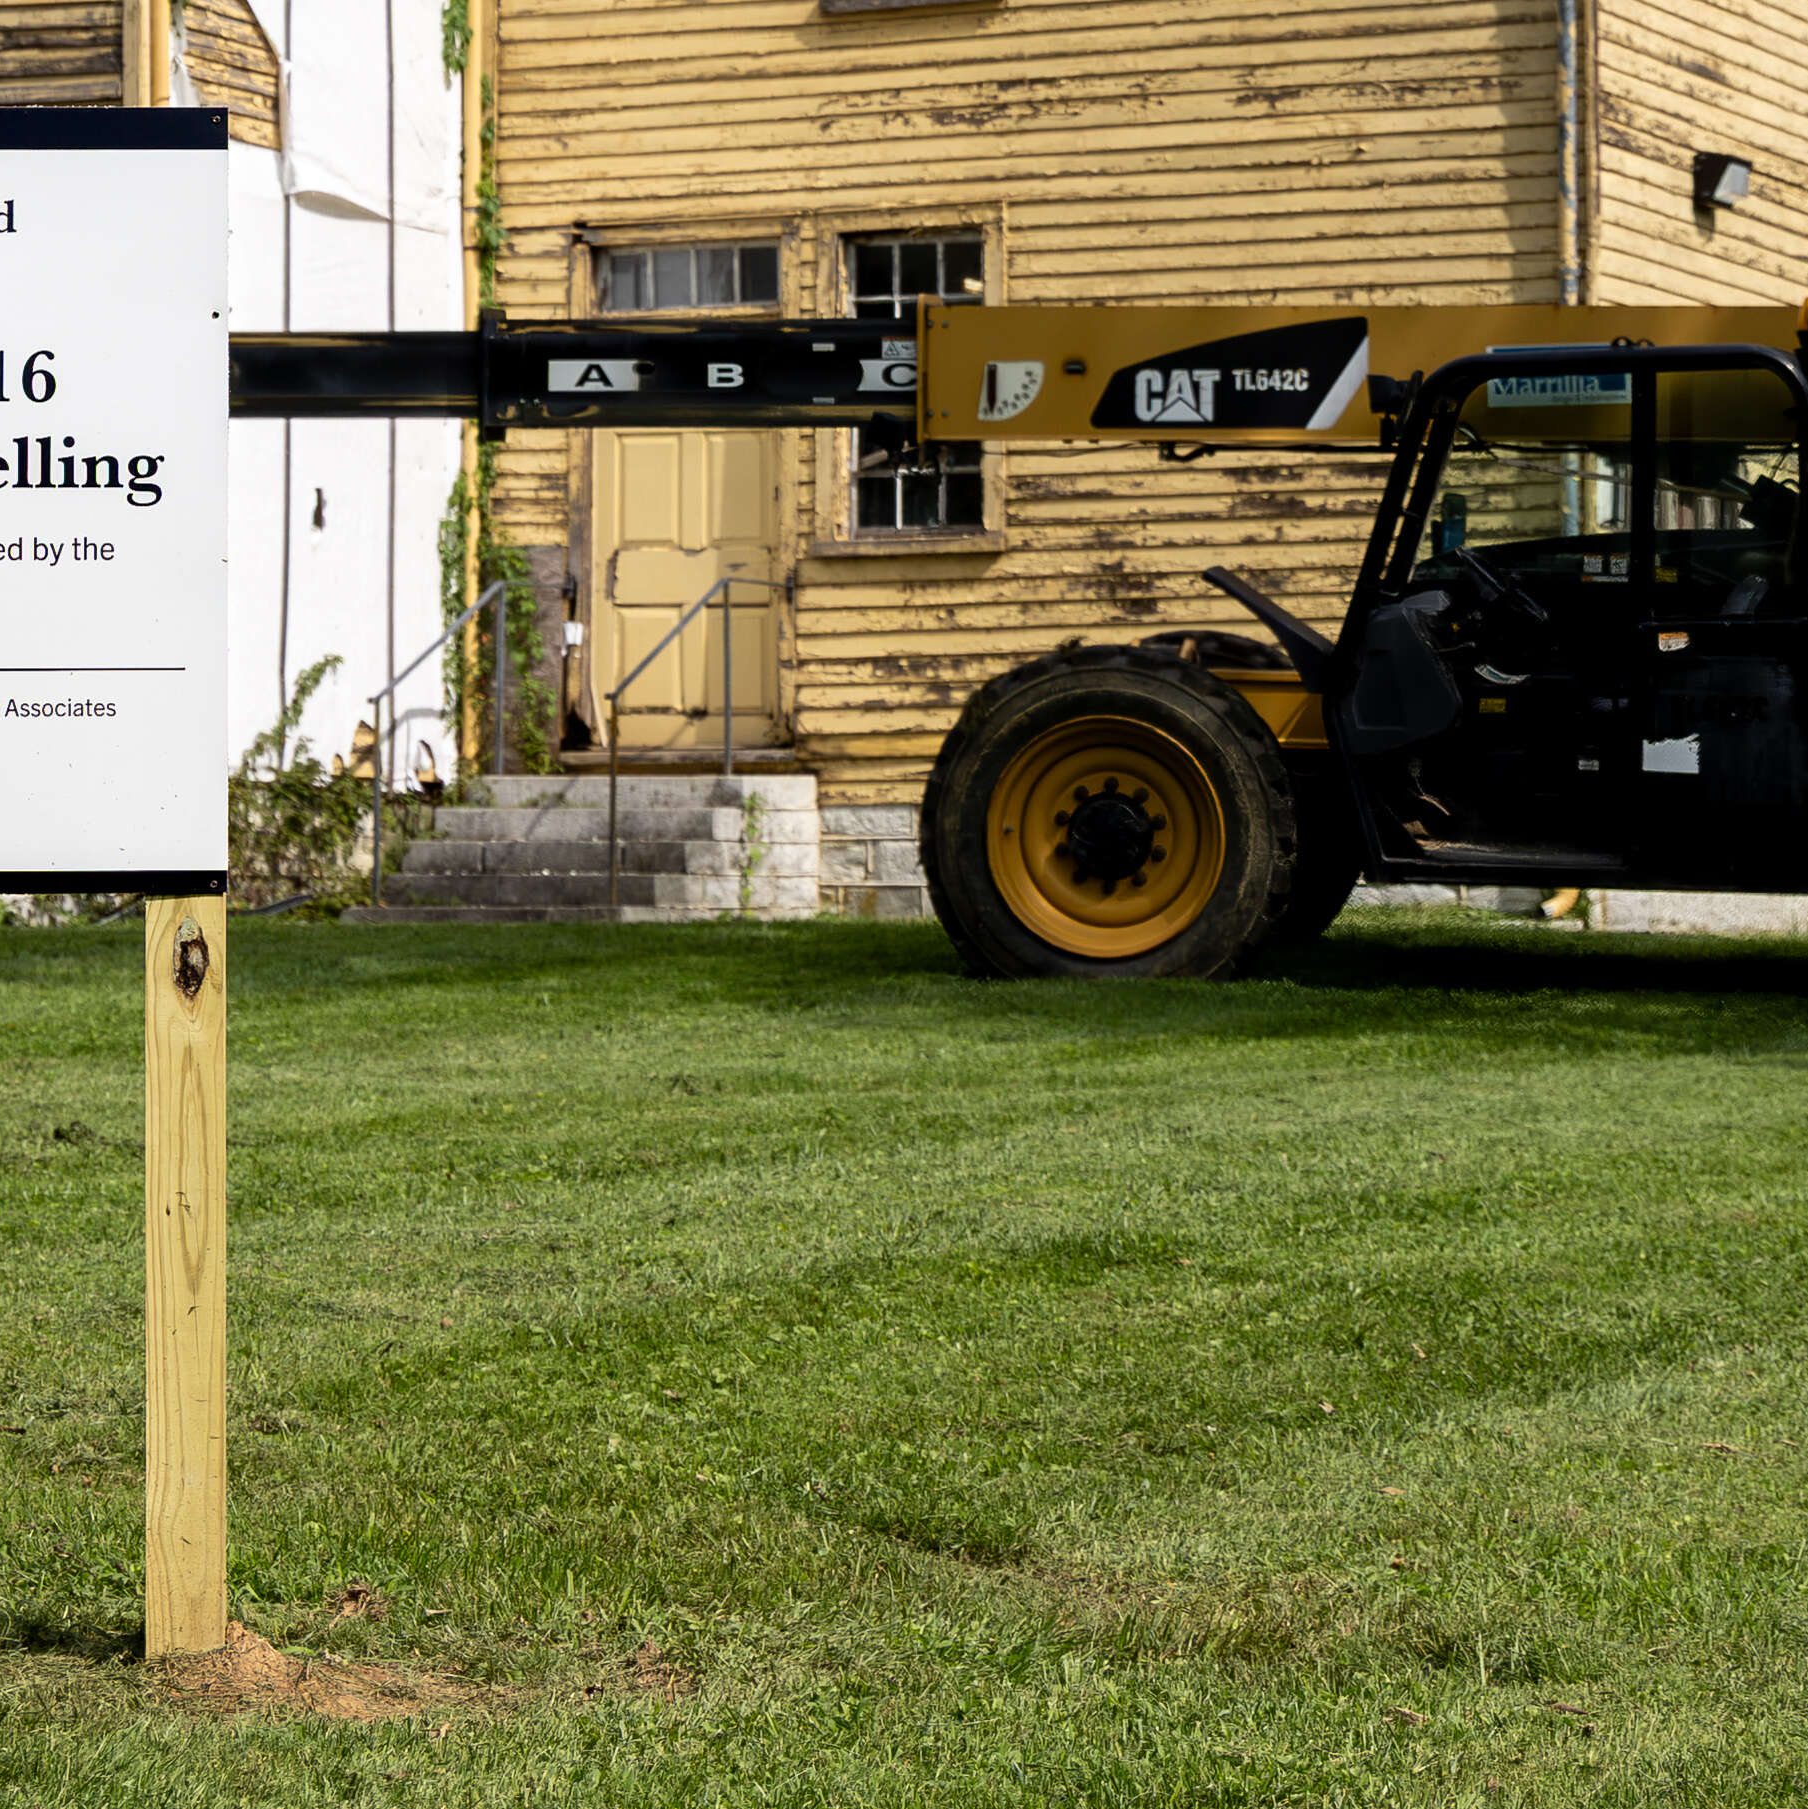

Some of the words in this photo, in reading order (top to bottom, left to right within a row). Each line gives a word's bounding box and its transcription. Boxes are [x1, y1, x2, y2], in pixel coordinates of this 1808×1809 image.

[575, 364, 613, 388] A
[708, 363, 744, 388] B
[882, 363, 917, 386] C
[1134, 369, 1221, 422] CAT
[1232, 368, 1309, 392] TL642C
[34, 537, 64, 566] by
[72, 537, 114, 560] the
[5, 699, 116, 717] Associates
